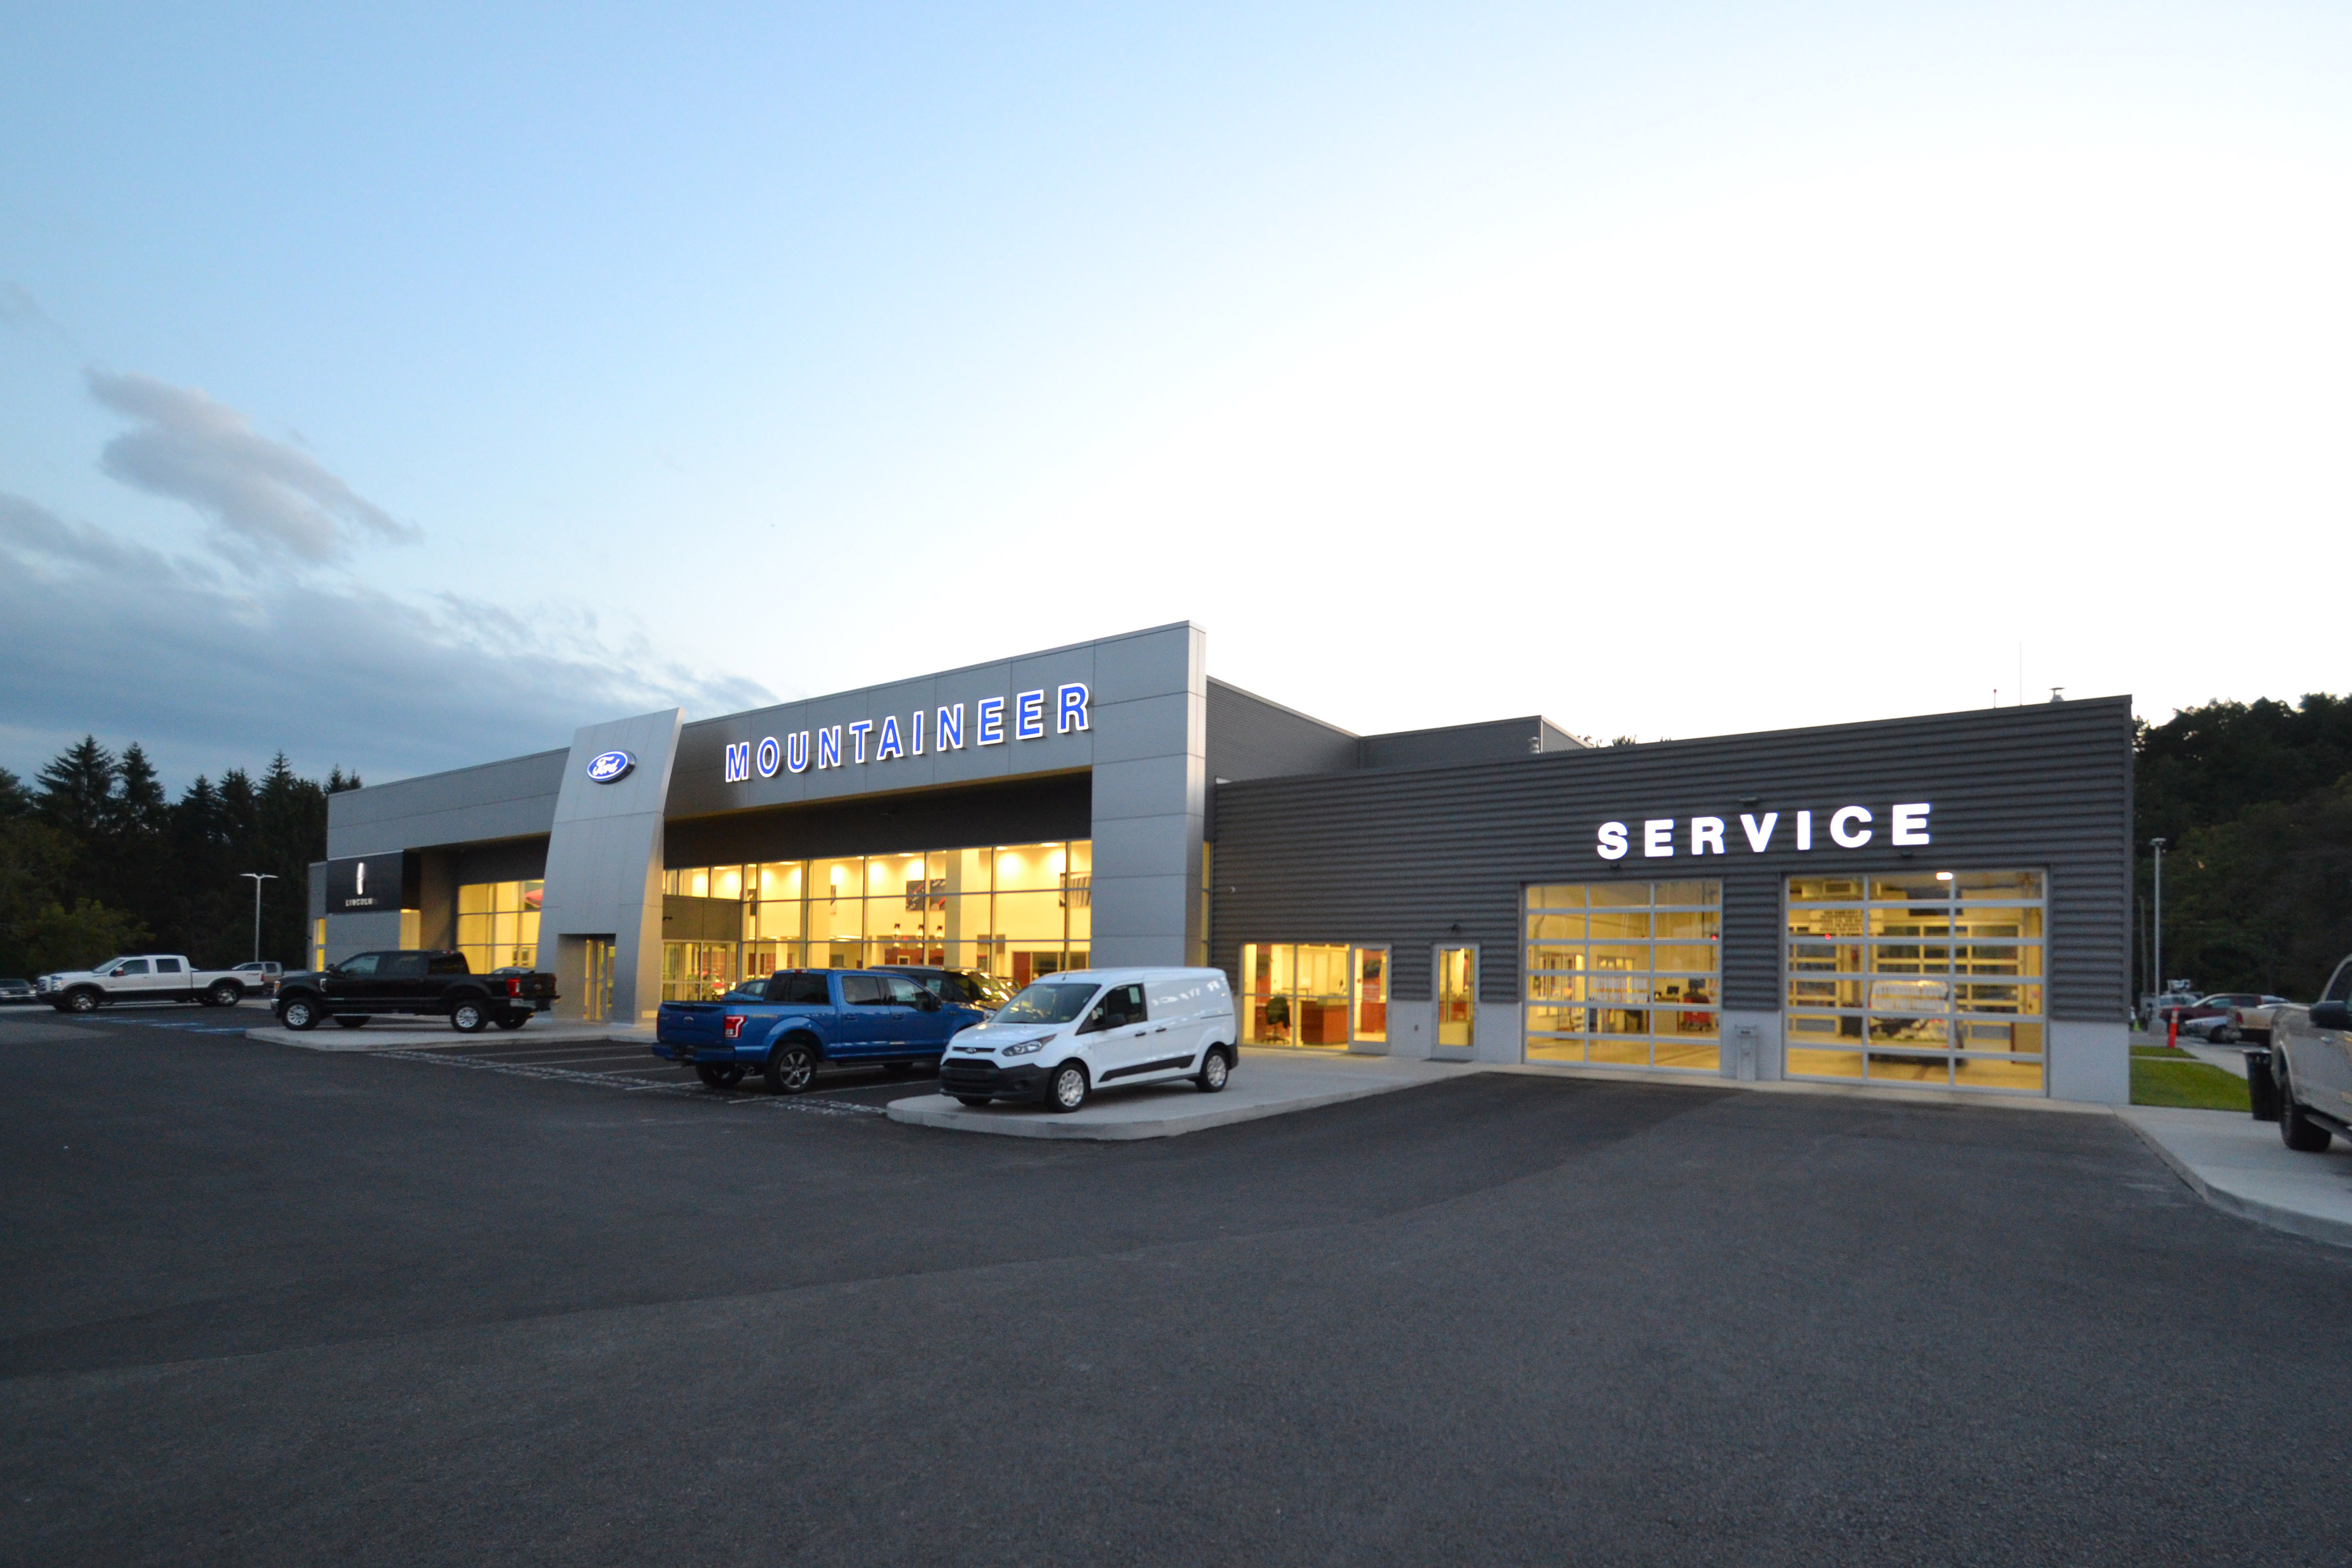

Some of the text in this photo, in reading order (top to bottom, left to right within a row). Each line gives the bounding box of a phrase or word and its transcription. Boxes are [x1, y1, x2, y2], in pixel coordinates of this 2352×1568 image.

[725, 682, 1089, 782] MOUNTAINEER
[593, 756, 620, 776] Ford
[1597, 803, 1930, 860] SERVICE
[345, 898, 373, 906] LINCOLN
